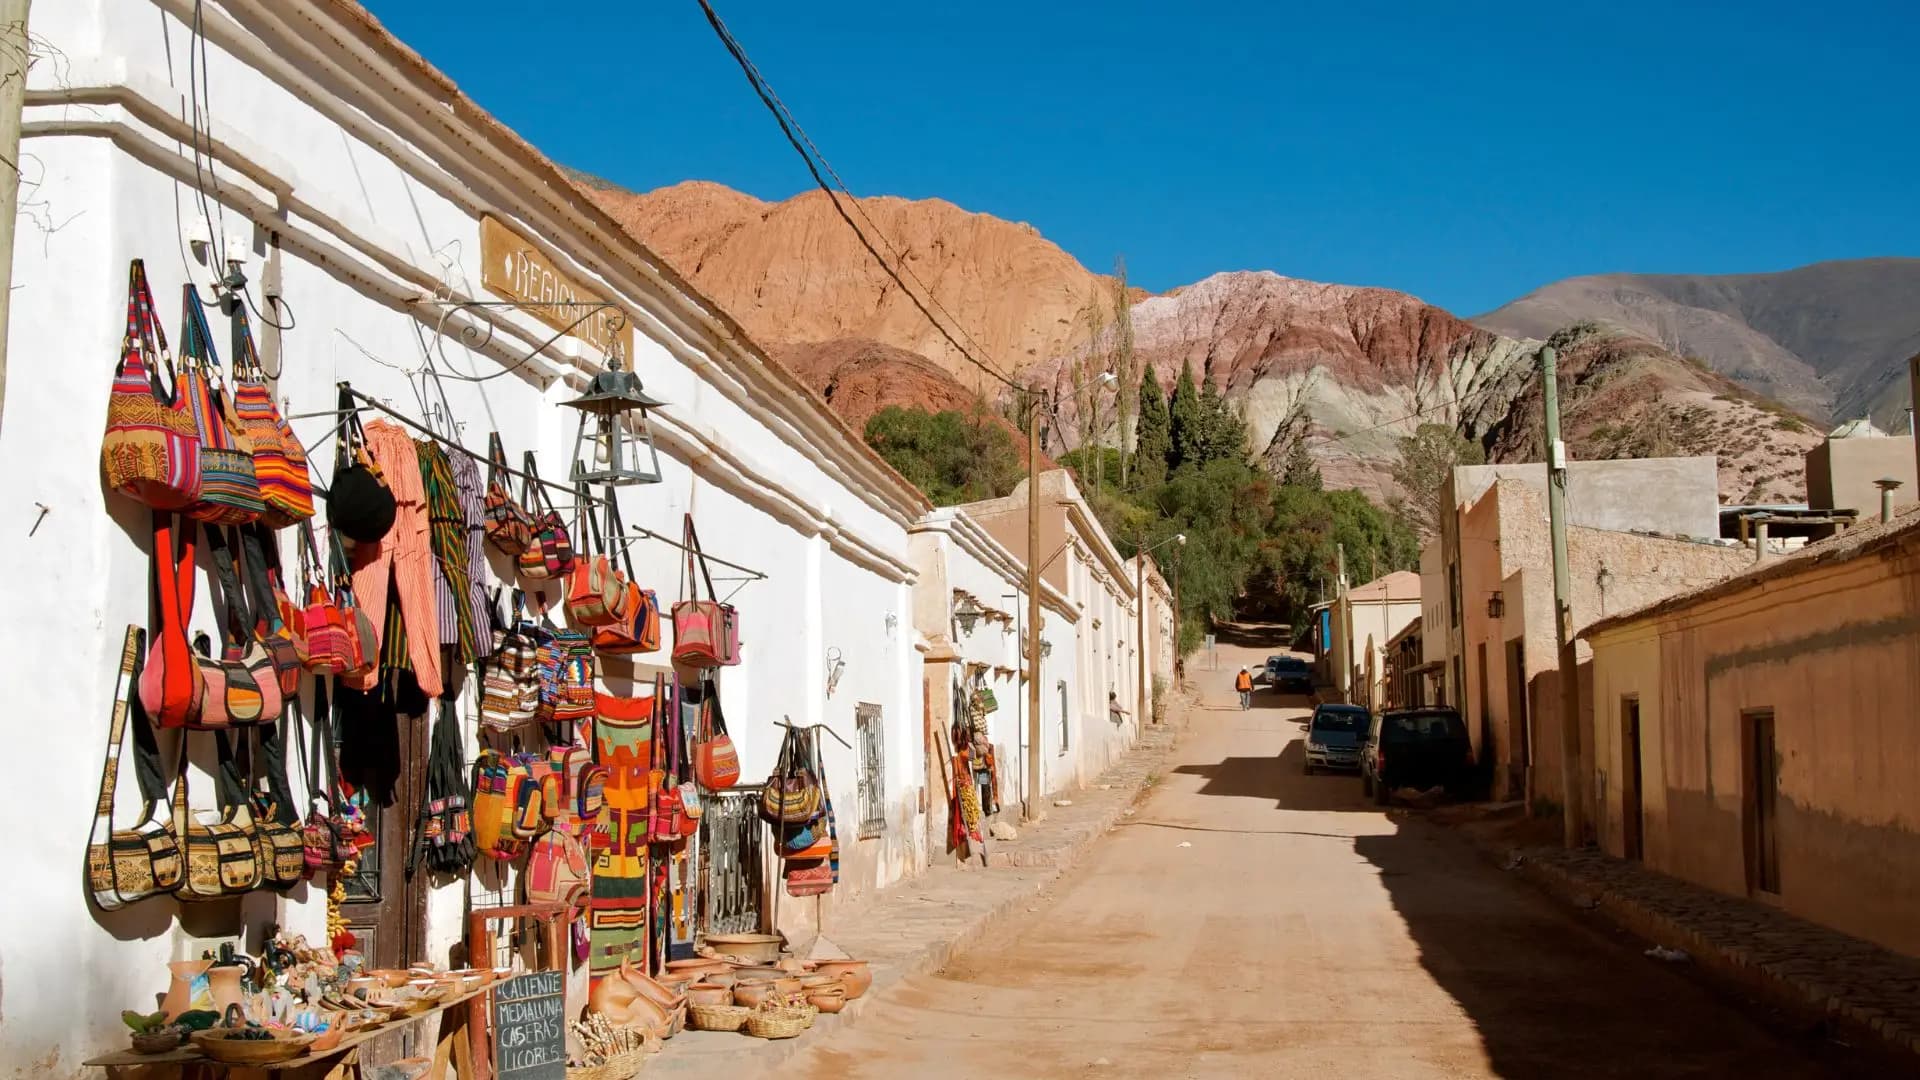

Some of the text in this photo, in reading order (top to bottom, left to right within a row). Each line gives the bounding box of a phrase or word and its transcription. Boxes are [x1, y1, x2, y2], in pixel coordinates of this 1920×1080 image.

[500, 998, 562, 1024] MEDIALUNA
[501, 1018, 559, 1047] CASERAS
[504, 1044, 560, 1071] LICORES
